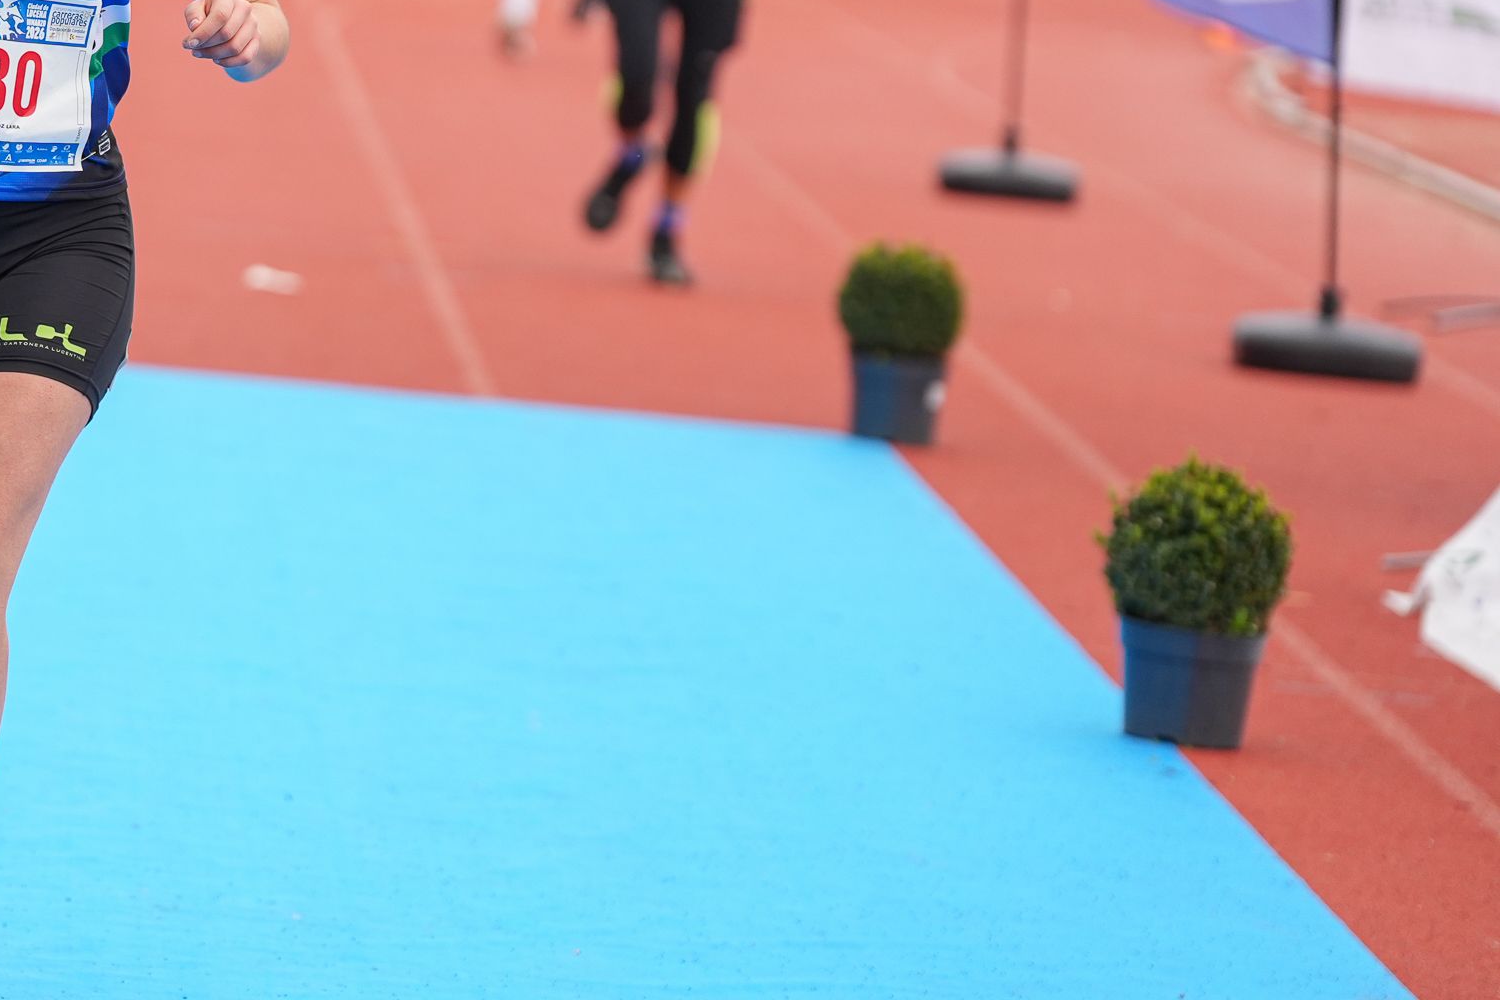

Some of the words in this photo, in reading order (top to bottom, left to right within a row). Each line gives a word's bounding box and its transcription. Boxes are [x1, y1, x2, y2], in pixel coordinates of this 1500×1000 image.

[52, 11, 83, 20] carreras
[50, 18, 87, 27] populares
[26, 26, 46, 40] 2026
[3, 340, 50, 350] CARTONERA
[51, 346, 86, 362] LUCENTINA
